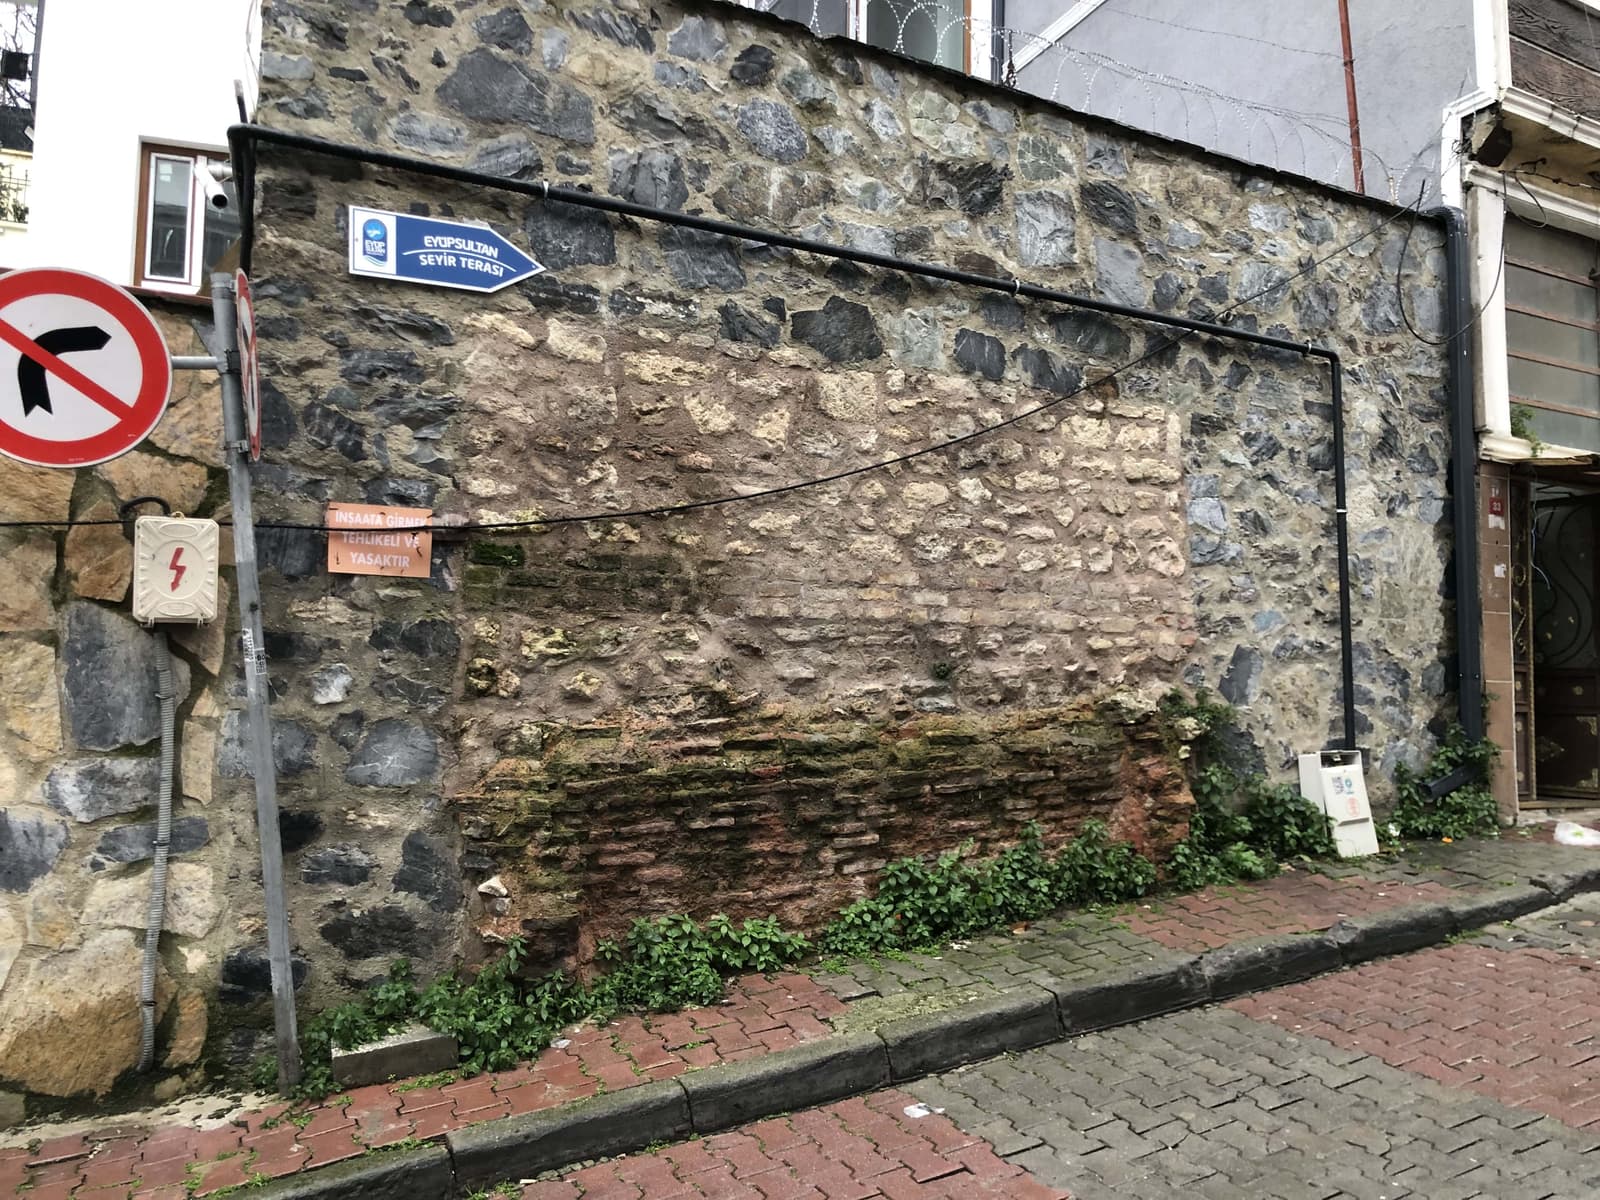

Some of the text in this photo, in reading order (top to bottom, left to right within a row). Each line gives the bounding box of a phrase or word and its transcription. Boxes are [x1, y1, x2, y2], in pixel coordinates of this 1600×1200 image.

[424, 235, 498, 257] EYÜPSULTAN
[419, 252, 504, 277] SEYİR TERASI
[404, 535, 420, 548] VE
[349, 551, 411, 568] YASAKTIR
